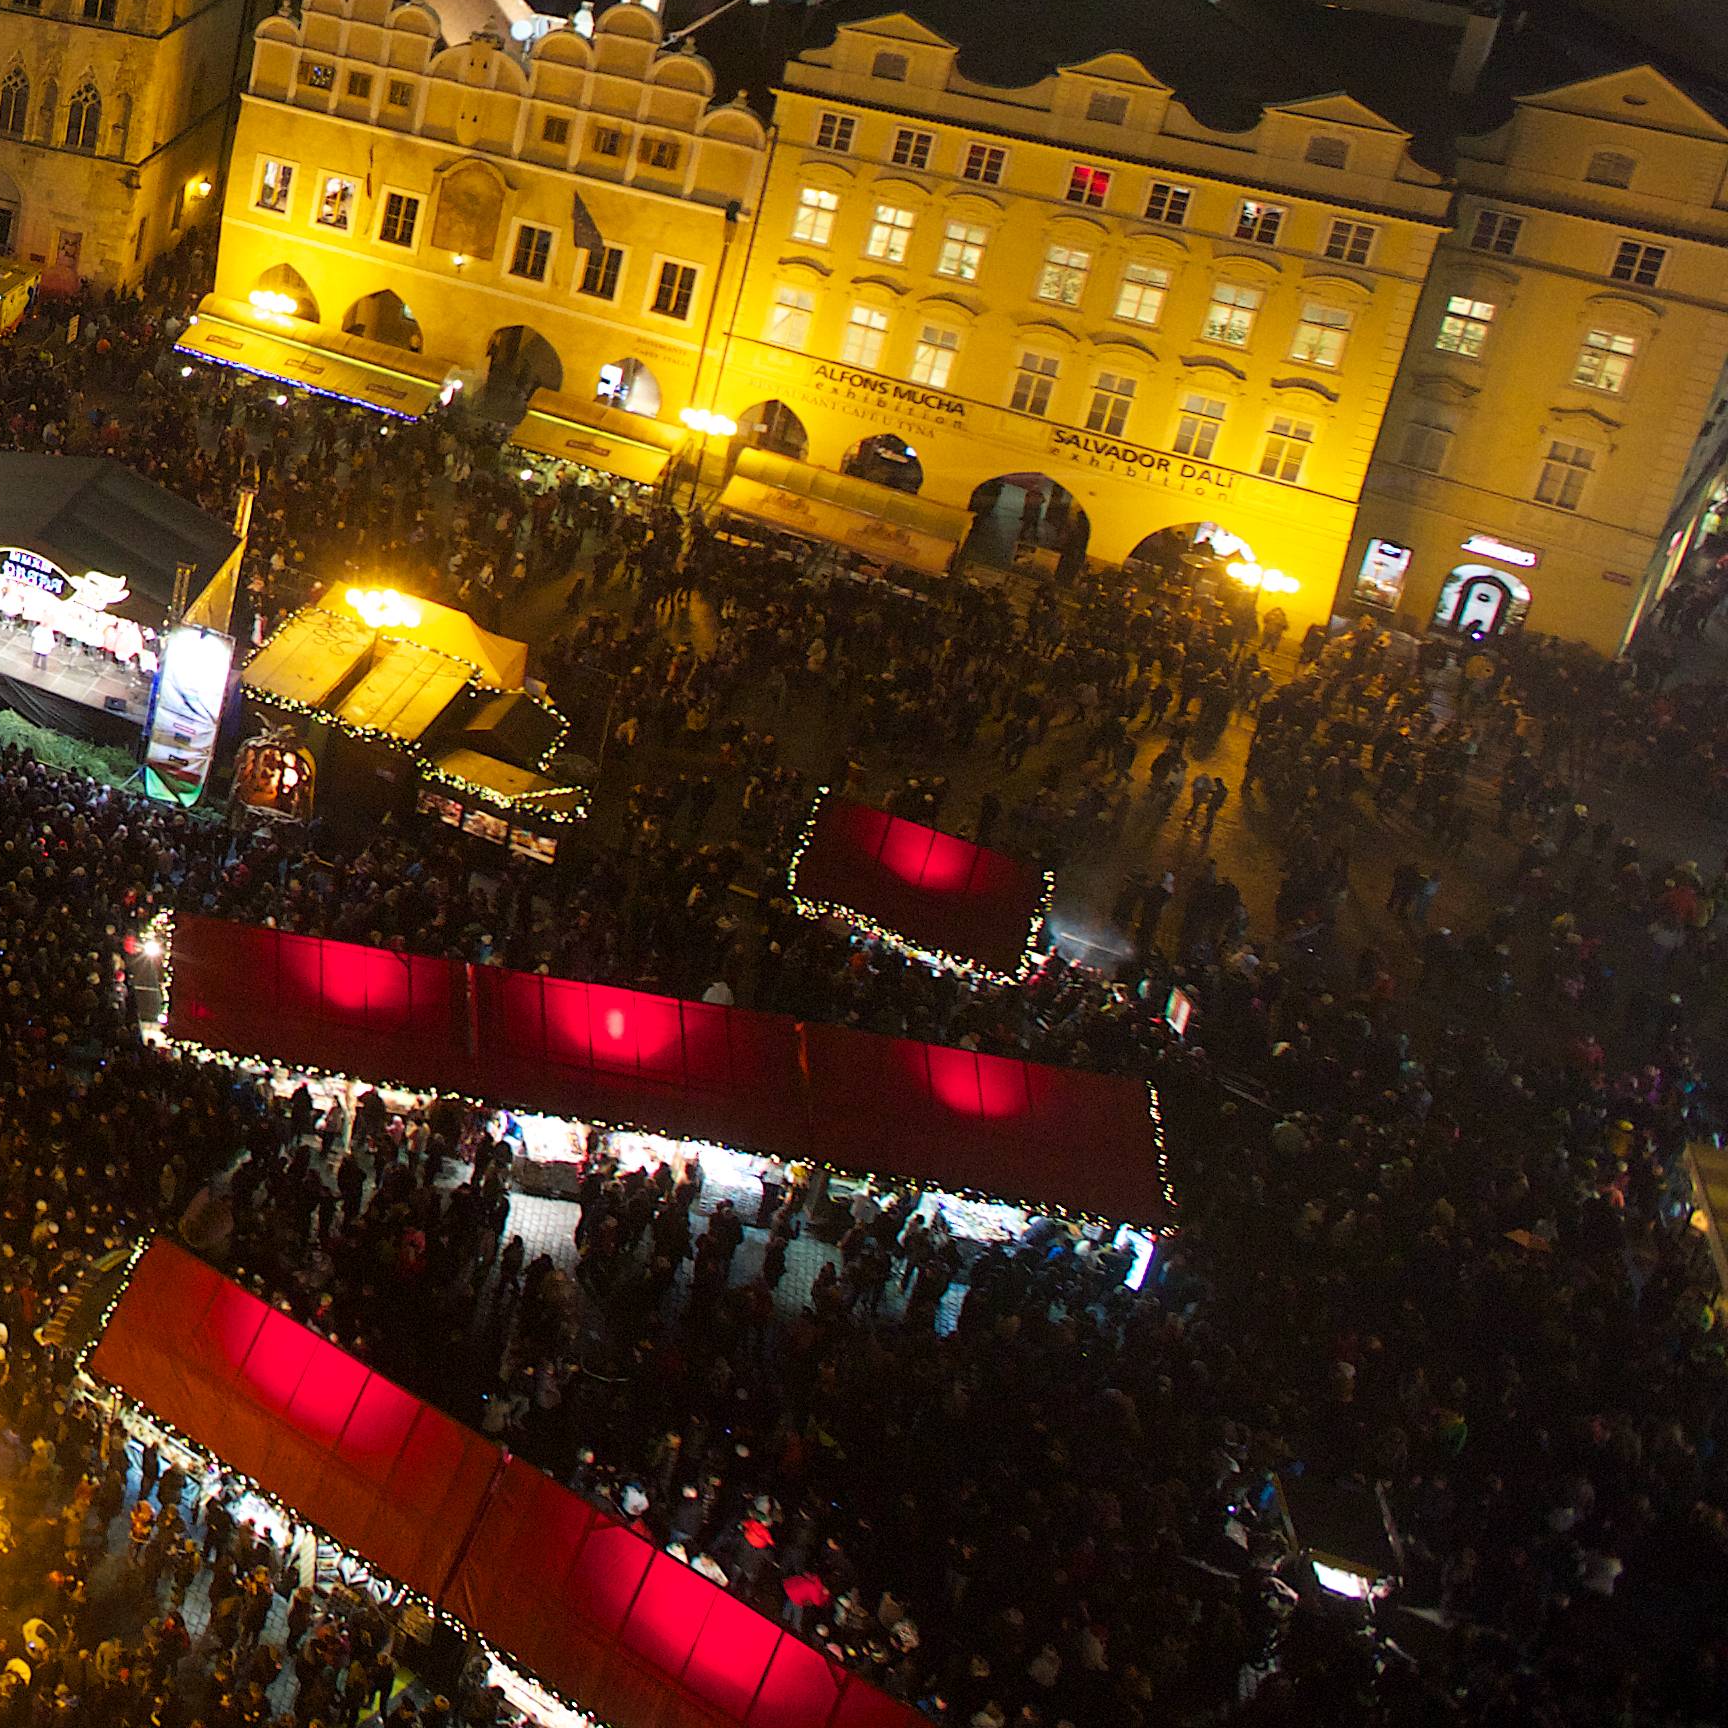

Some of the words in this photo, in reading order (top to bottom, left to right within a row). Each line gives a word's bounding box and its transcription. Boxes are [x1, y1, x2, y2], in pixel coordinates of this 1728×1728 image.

[815, 365, 889, 395] ALFONS
[892, 385, 966, 417] MUCHA
[815, 382, 964, 428] exhibition
[1049, 447, 1232, 501] exhibition
[1054, 429, 1171, 472] SALVADOR
